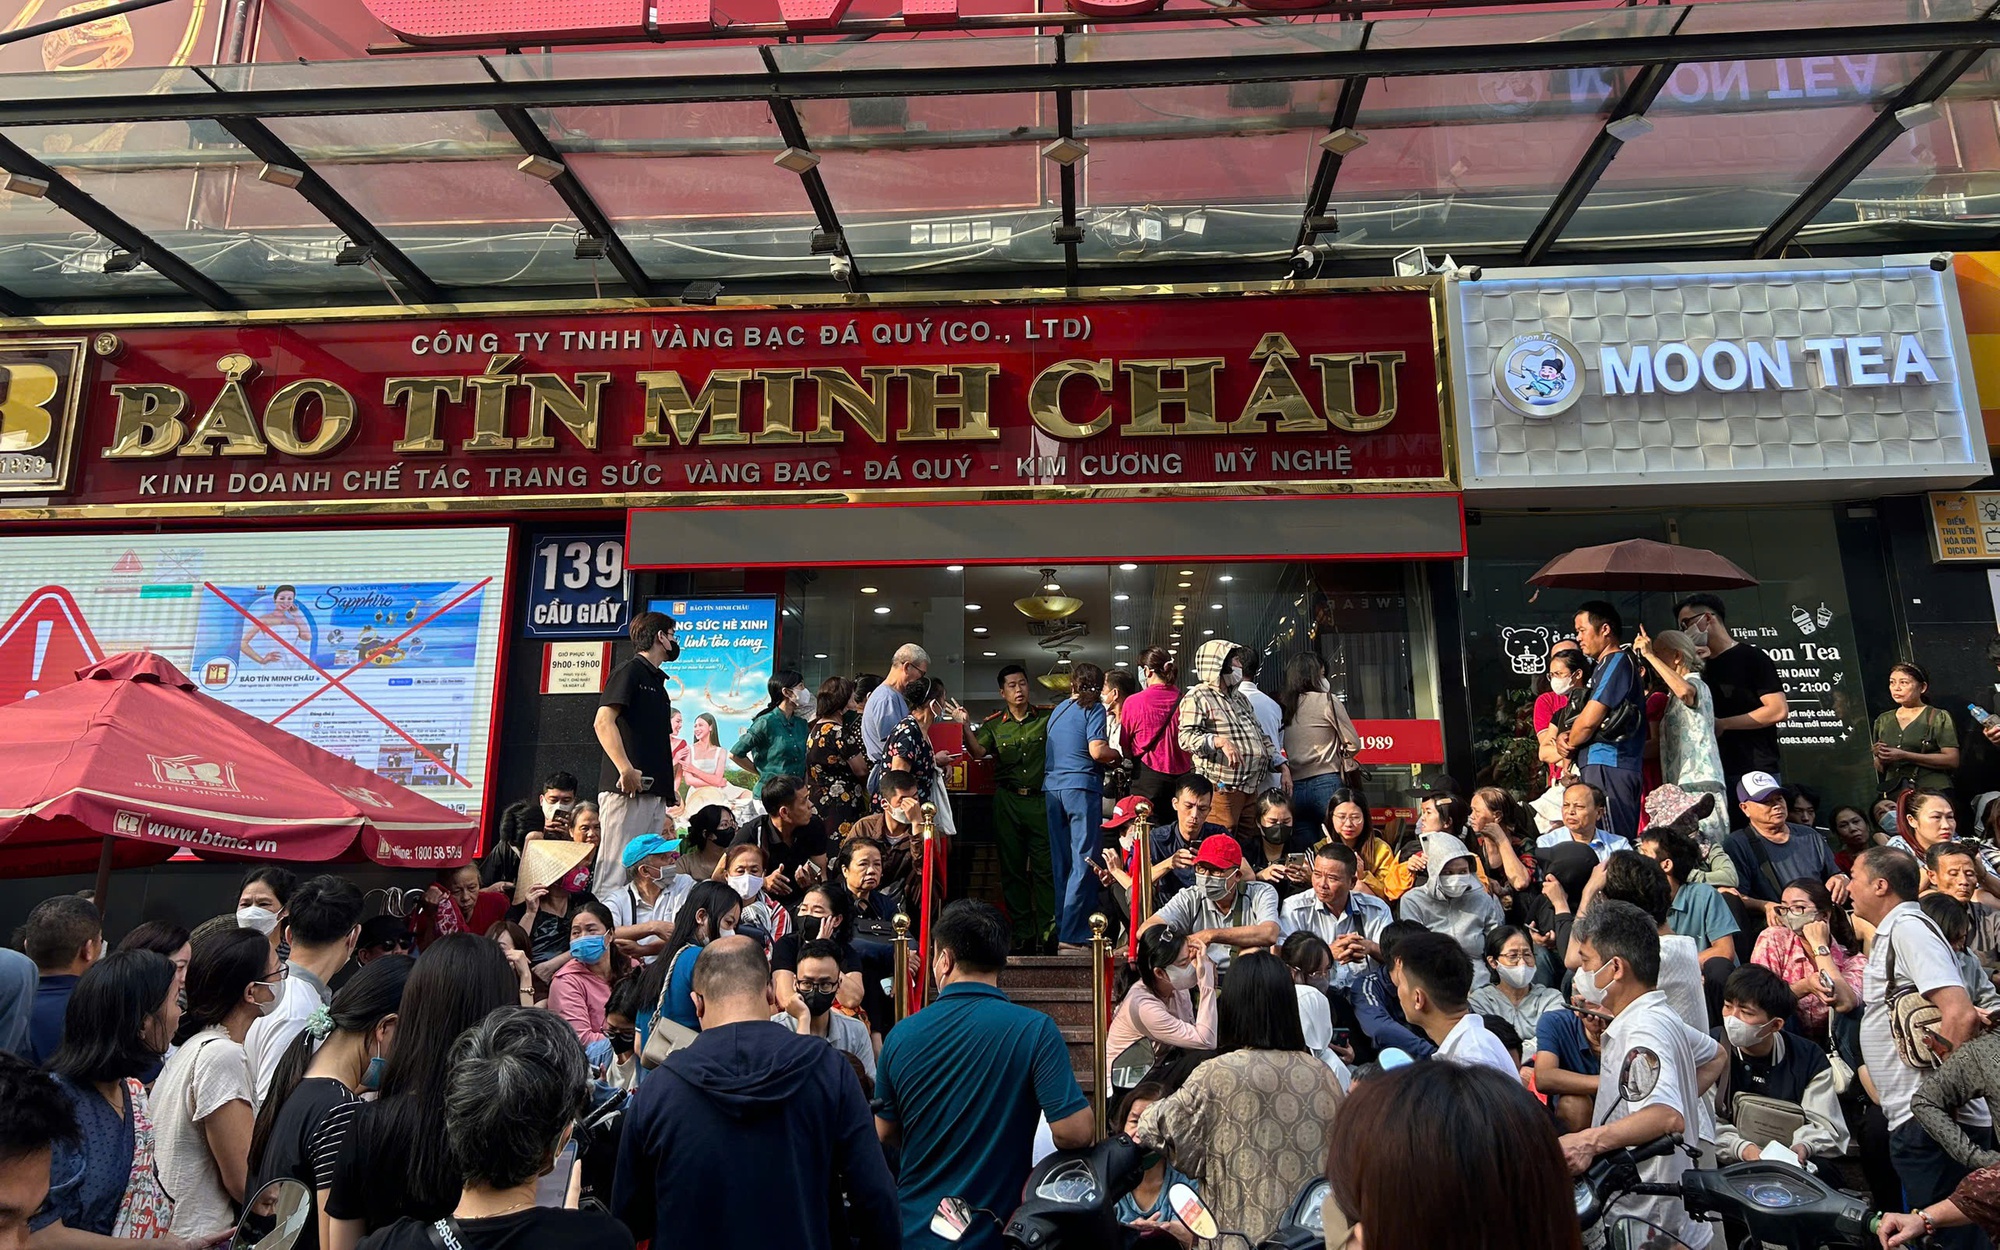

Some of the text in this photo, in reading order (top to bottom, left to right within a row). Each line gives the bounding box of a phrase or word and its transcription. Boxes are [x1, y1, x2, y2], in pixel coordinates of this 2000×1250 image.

[411, 329, 498, 355] CÔNG
[515, 331, 550, 352] TY
[559, 329, 641, 350] TNHH
[652, 323, 733, 348] VÀNG
[744, 325, 805, 350] BẠC
[820, 319, 859, 345] ĐÁ
[872, 317, 933, 344] QUÝ
[1025, 315, 1091, 341] LTD)
[1514, 334, 1539, 345] Moon
[1599, 334, 1940, 396] MOON TEA
[101, 331, 1407, 459] BẢO TÍN MINH CHÂU
[139, 473, 215, 495] KINH
[228, 471, 331, 494] DOANH
[343, 461, 404, 492] CHẾ
[414, 464, 471, 490] TÁC
[485, 465, 587, 488] TRANG
[601, 460, 662, 486] SỨC
[685, 459, 761, 484] VÀNG
[774, 461, 831, 487] BẠC
[864, 455, 902, 481] ĐÁ
[912, 453, 973, 480] QUÝ
[1016, 455, 1066, 478] KIM
[1080, 451, 1183, 475] CƯƠNG
[1215, 446, 1257, 473] MỸ
[1271, 443, 1353, 475] NGHỆ
[1941, 528, 1957, 536] THU
[539, 540, 623, 590] 139
[315, 585, 393, 614] Sapphire
[534, 596, 622, 625] CẦU GIẤY
[696, 618, 720, 631] SỨC
[723, 618, 737, 630] HÈ
[739, 620, 768, 630] XINH
[1731, 627, 1778, 639] Tiệm Trà
[733, 635, 768, 653] sáng
[1800, 642, 1840, 661] Tea
[240, 674, 256, 682] BẢO
[257, 674, 270, 682] TÍN
[1776, 668, 1820, 678] EN DAILY
[1800, 682, 1831, 693] 21:00
[1799, 709, 1815, 719] một
[1816, 708, 1836, 718] chút
[1788, 719, 1803, 728] làm
[1821, 719, 1843, 728] mood
[1359, 736, 1394, 750] 1989
[1780, 736, 1836, 745] 0983.960.996
[147, 821, 278, 853] www.btmc.vn
[414, 845, 433, 860] 1800
[433, 845, 445, 860] 58
